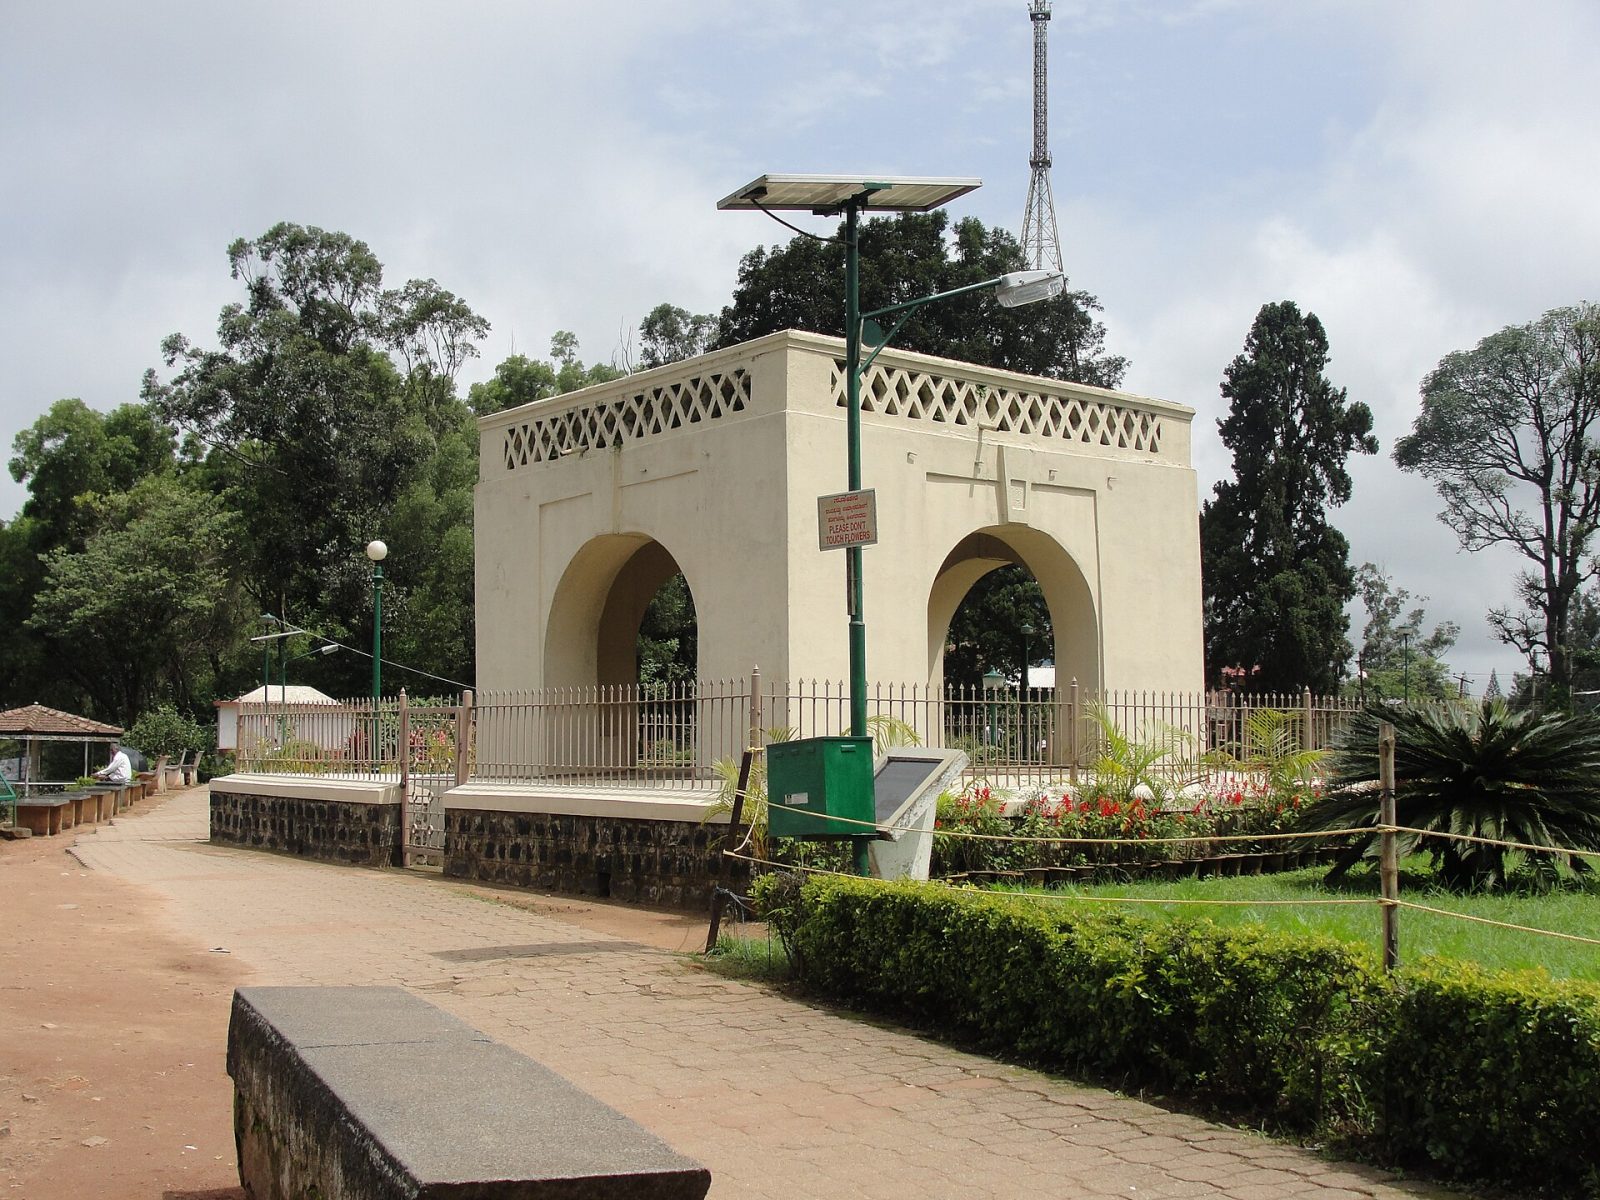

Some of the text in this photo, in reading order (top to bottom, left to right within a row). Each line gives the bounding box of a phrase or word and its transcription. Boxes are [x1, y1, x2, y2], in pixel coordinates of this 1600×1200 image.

[829, 523, 849, 534] PLEASE
[826, 531, 870, 544] TOUCH FLOWERS
